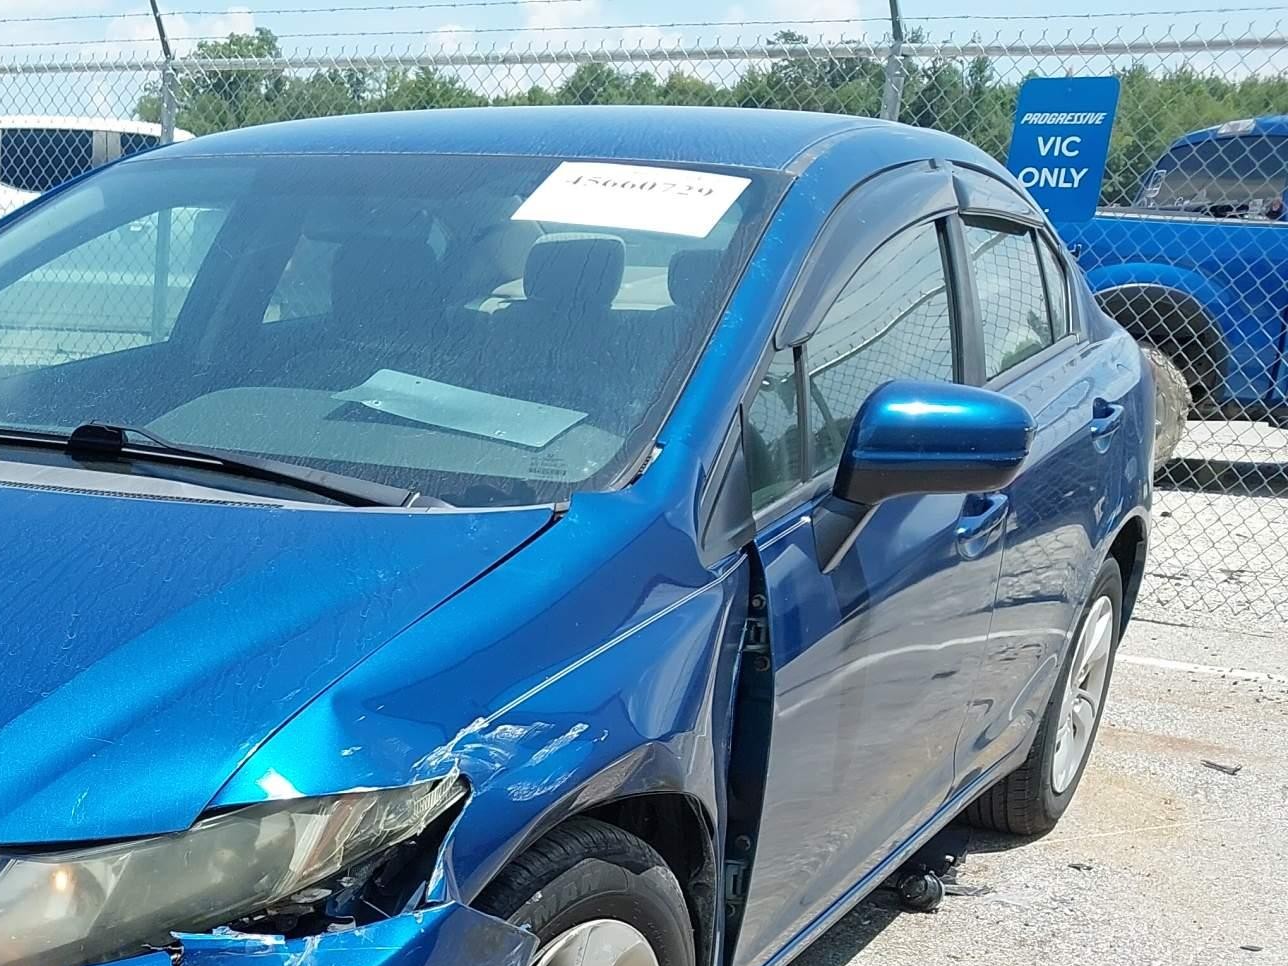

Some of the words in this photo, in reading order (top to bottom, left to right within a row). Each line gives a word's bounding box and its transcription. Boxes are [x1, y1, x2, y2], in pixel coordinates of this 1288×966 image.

[1020, 112, 1108, 125] PROGRESSIVE
[1037, 136, 1082, 157] VIC
[1017, 167, 1089, 188] ONLY
